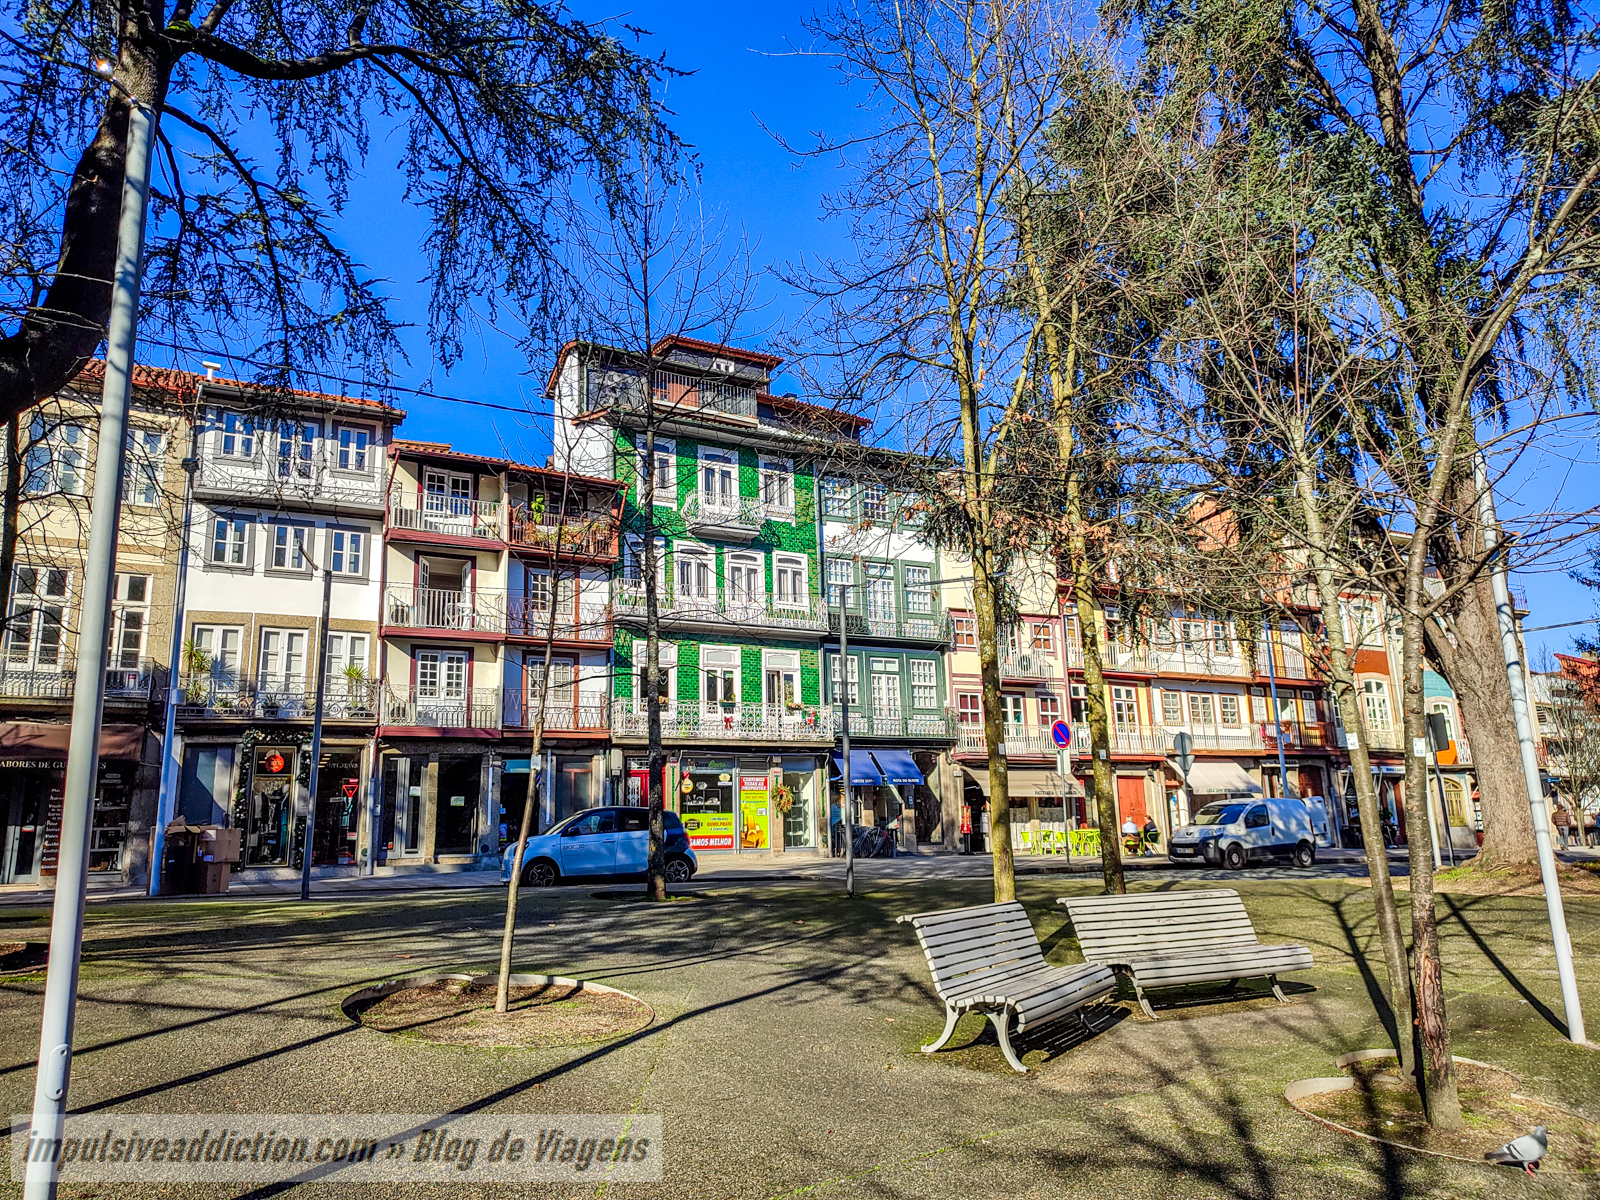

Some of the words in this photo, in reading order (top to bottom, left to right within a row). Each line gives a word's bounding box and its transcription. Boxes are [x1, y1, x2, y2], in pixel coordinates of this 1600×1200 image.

[0, 760, 36, 769] ABORES
[38, 761, 51, 769] DE
[690, 838, 709, 847] GAMOS
[709, 837, 732, 846] MELHOR
